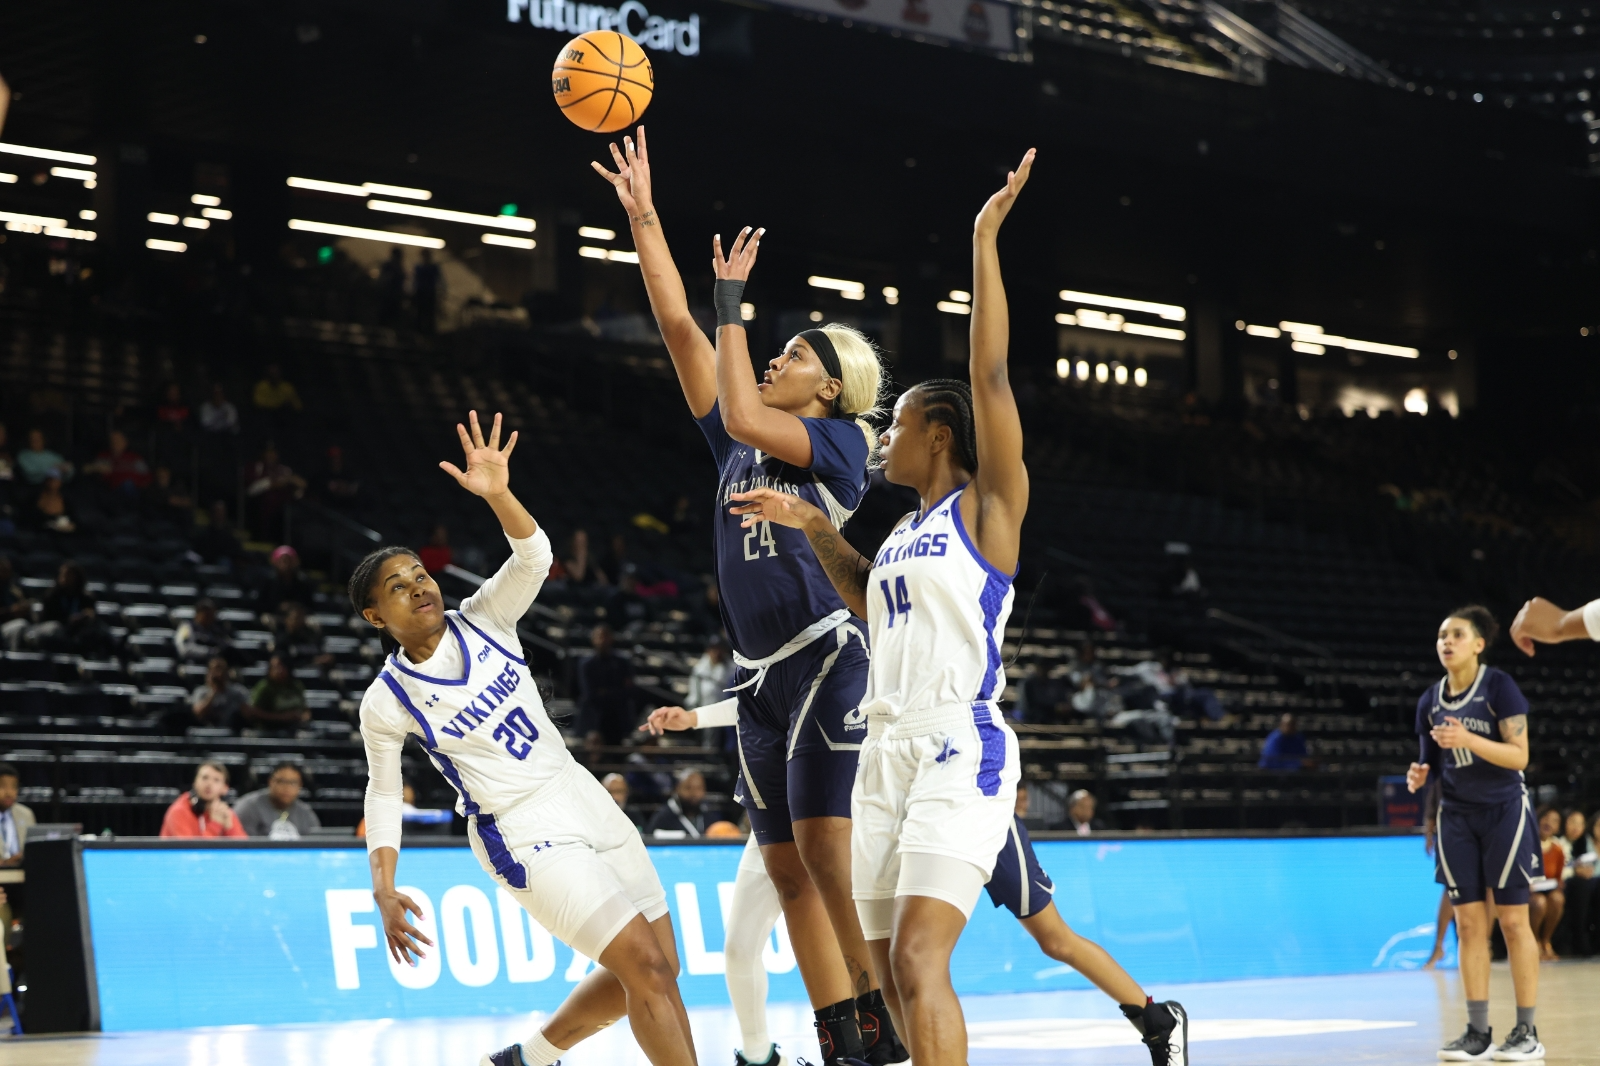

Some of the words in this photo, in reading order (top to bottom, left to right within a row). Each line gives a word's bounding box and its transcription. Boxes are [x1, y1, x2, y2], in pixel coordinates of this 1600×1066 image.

[742, 513, 778, 561] 24
[872, 533, 949, 570] IKINGS
[880, 575, 912, 629] 14
[441, 661, 521, 740] VIKINGS
[492, 706, 539, 761] 20
[325, 884, 556, 990] FOOD
